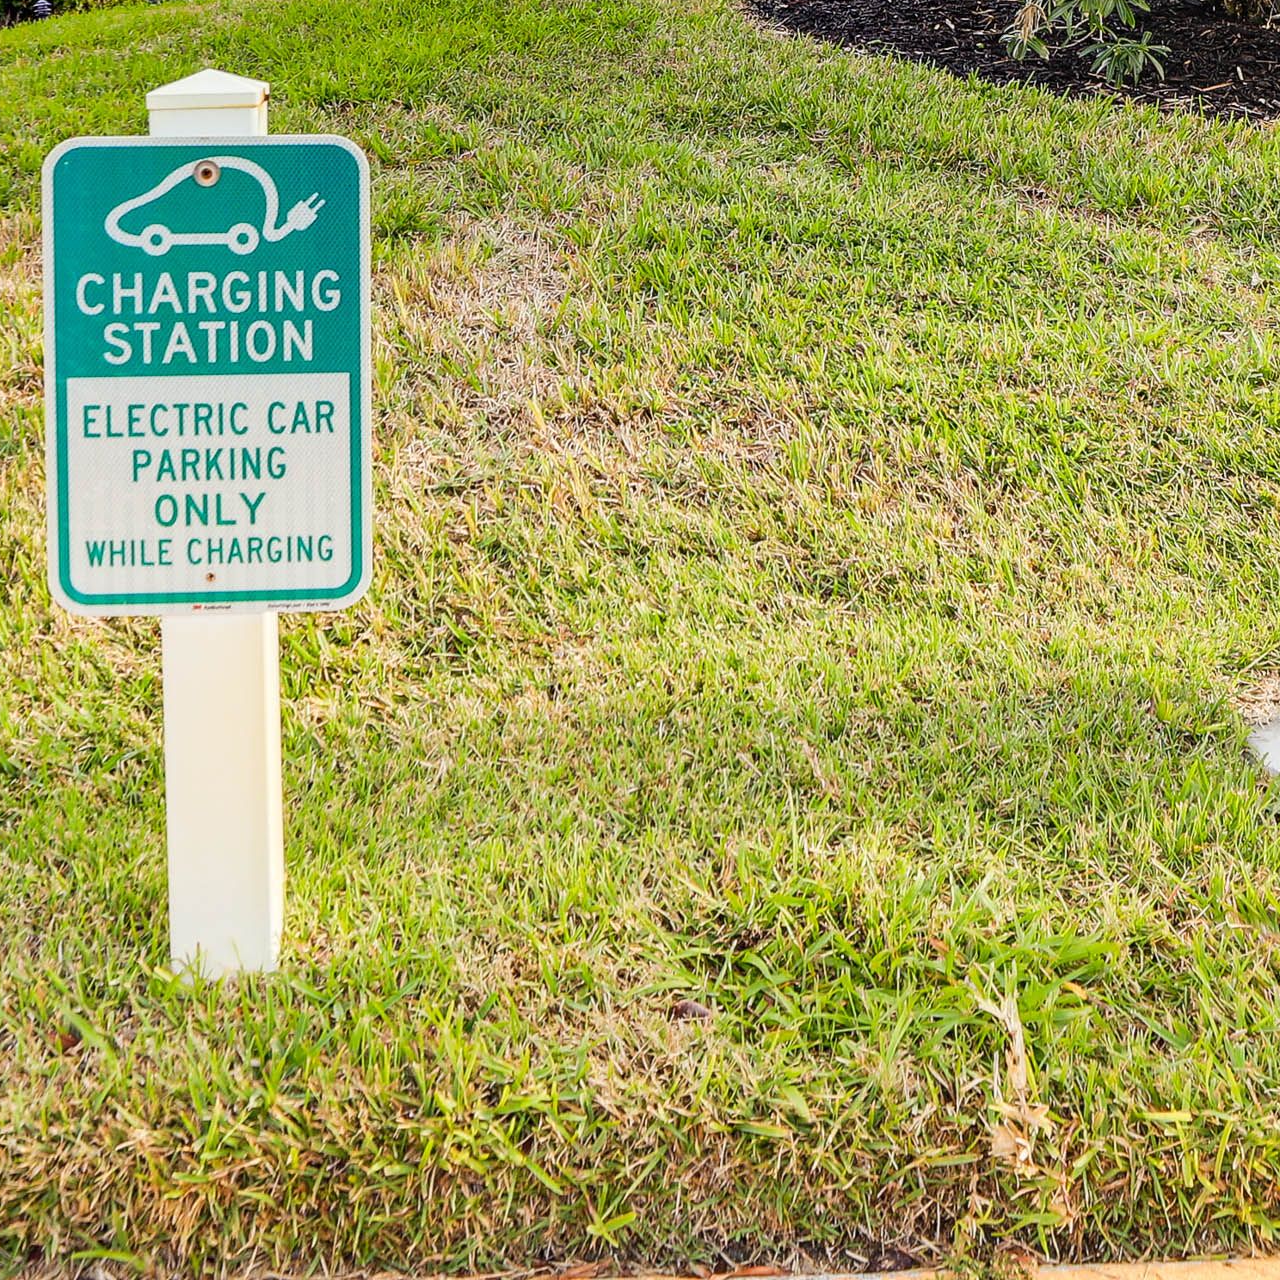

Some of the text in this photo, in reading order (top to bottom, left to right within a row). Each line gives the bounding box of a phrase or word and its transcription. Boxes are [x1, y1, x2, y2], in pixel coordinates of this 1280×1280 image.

[75, 269, 342, 316] CHARGING
[102, 319, 314, 366] STATION
[82, 400, 336, 438] ELECTRIC CAR
[131, 446, 288, 483] PARKING
[154, 491, 267, 528] ONLY
[85, 534, 334, 568] WHILE CHARGING
